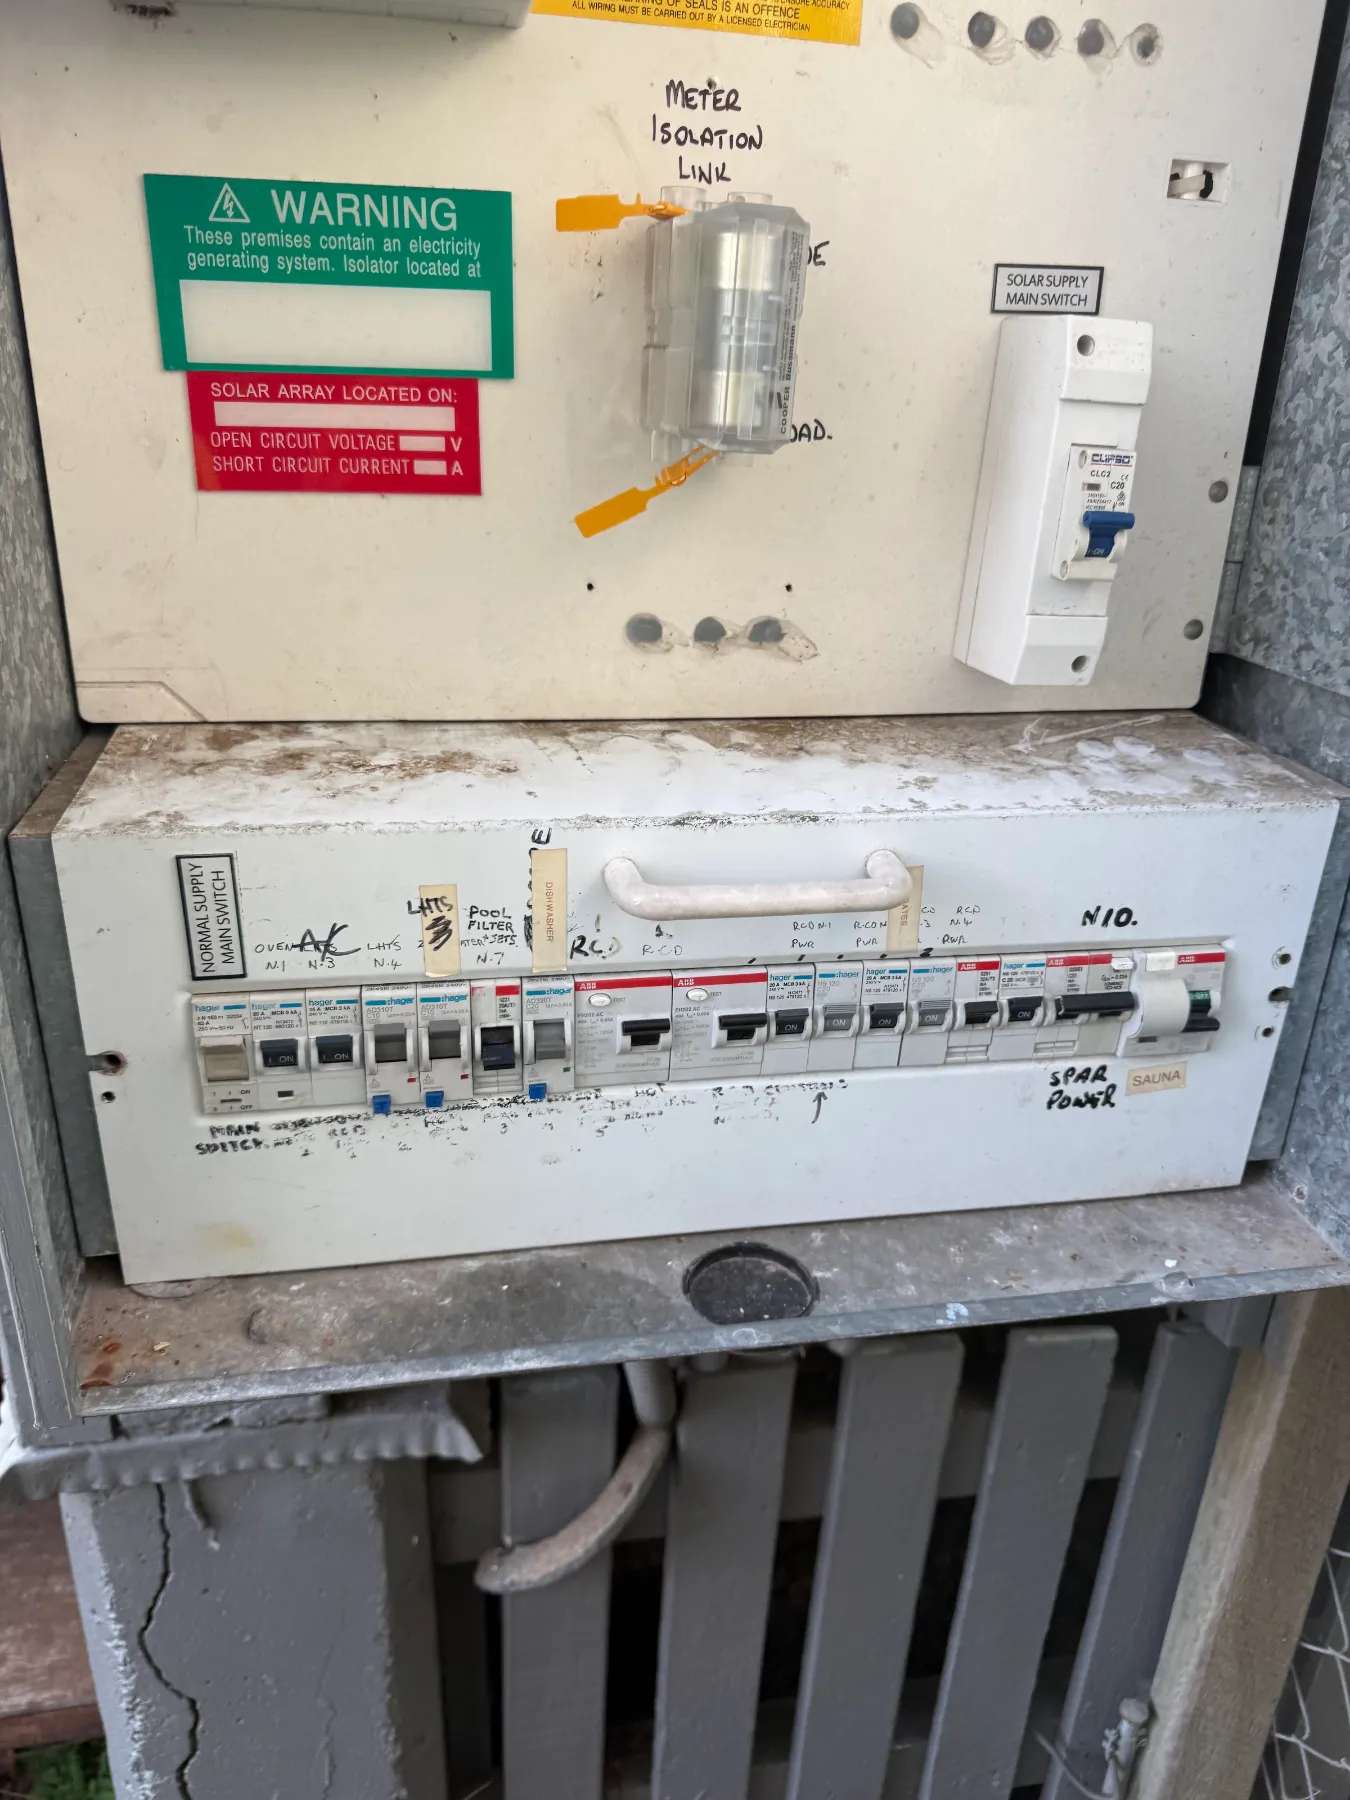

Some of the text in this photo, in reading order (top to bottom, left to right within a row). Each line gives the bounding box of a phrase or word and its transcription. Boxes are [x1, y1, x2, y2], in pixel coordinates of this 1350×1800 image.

[685, 0, 717, 11] SEALS
[721, 1, 731, 12] IS
[734, 2, 748, 14] AN
[752, 4, 799, 19] OFFENCE
[812, 0, 850, 10] ACCURACY
[572, 2, 586, 10] ALL
[588, 3, 616, 13] WIRING
[618, 6, 639, 16] MUST
[654, 8, 687, 20] CARRIED
[690, 12, 704, 21] OUT
[707, 13, 717, 22] BY
[718, 15, 724, 24] A
[726, 16, 763, 27] LICENSED
[764, 19, 811, 32] ELECTRICIAN
[666, 79, 742, 112] METER
[652, 113, 763, 150] ISOLATION
[678, 155, 731, 184] LINK
[271, 189, 457, 232] WARNING
[183, 225, 481, 260] These premises contain an electricity
[187, 251, 482, 278] generating system. Isolator located at
[1006, 273, 1089, 289] SOLAR SUPPLY
[1006, 292, 1088, 307] MAIN SWITCH
[786, 325, 796, 381] Bussmann
[210, 382, 458, 404] SOLAR ARRAY LOCATED ON:
[780, 386, 790, 435] COOPER
[210, 432, 463, 453] OPEN CIRCUIT VOLTAGE V
[212, 456, 464, 476] SHORT CIRCUIT CURRENT A
[1110, 481, 1125, 490] C20
[188, 862, 216, 973] NORMAL SUPPLY
[211, 870, 236, 964] MAIN SWITCH
[469, 905, 512, 920] POOL
[546, 882, 554, 942] DISHWASHER
[468, 920, 514, 934] FILTER
[255, 943, 294, 953] OVEN
[930, 966, 954, 974] hager
[1004, 962, 1024, 970] hager
[1048, 958, 1064, 966] ABB
[770, 974, 792, 982] hager
[836, 970, 860, 978] hager
[866, 968, 886, 976] hager
[547, 988, 572, 996] hager
[580, 982, 597, 990] ABB
[308, 998, 334, 1006] hager
[388, 996, 414, 1006] hager
[442, 994, 468, 1002] hager
[924, 1014, 938, 1022] ON
[280, 1055, 294, 1063] ON
[1050, 1065, 1108, 1087] SPAR
[1132, 1070, 1181, 1087] SAUNA
[1046, 1083, 1117, 1110] POWER
